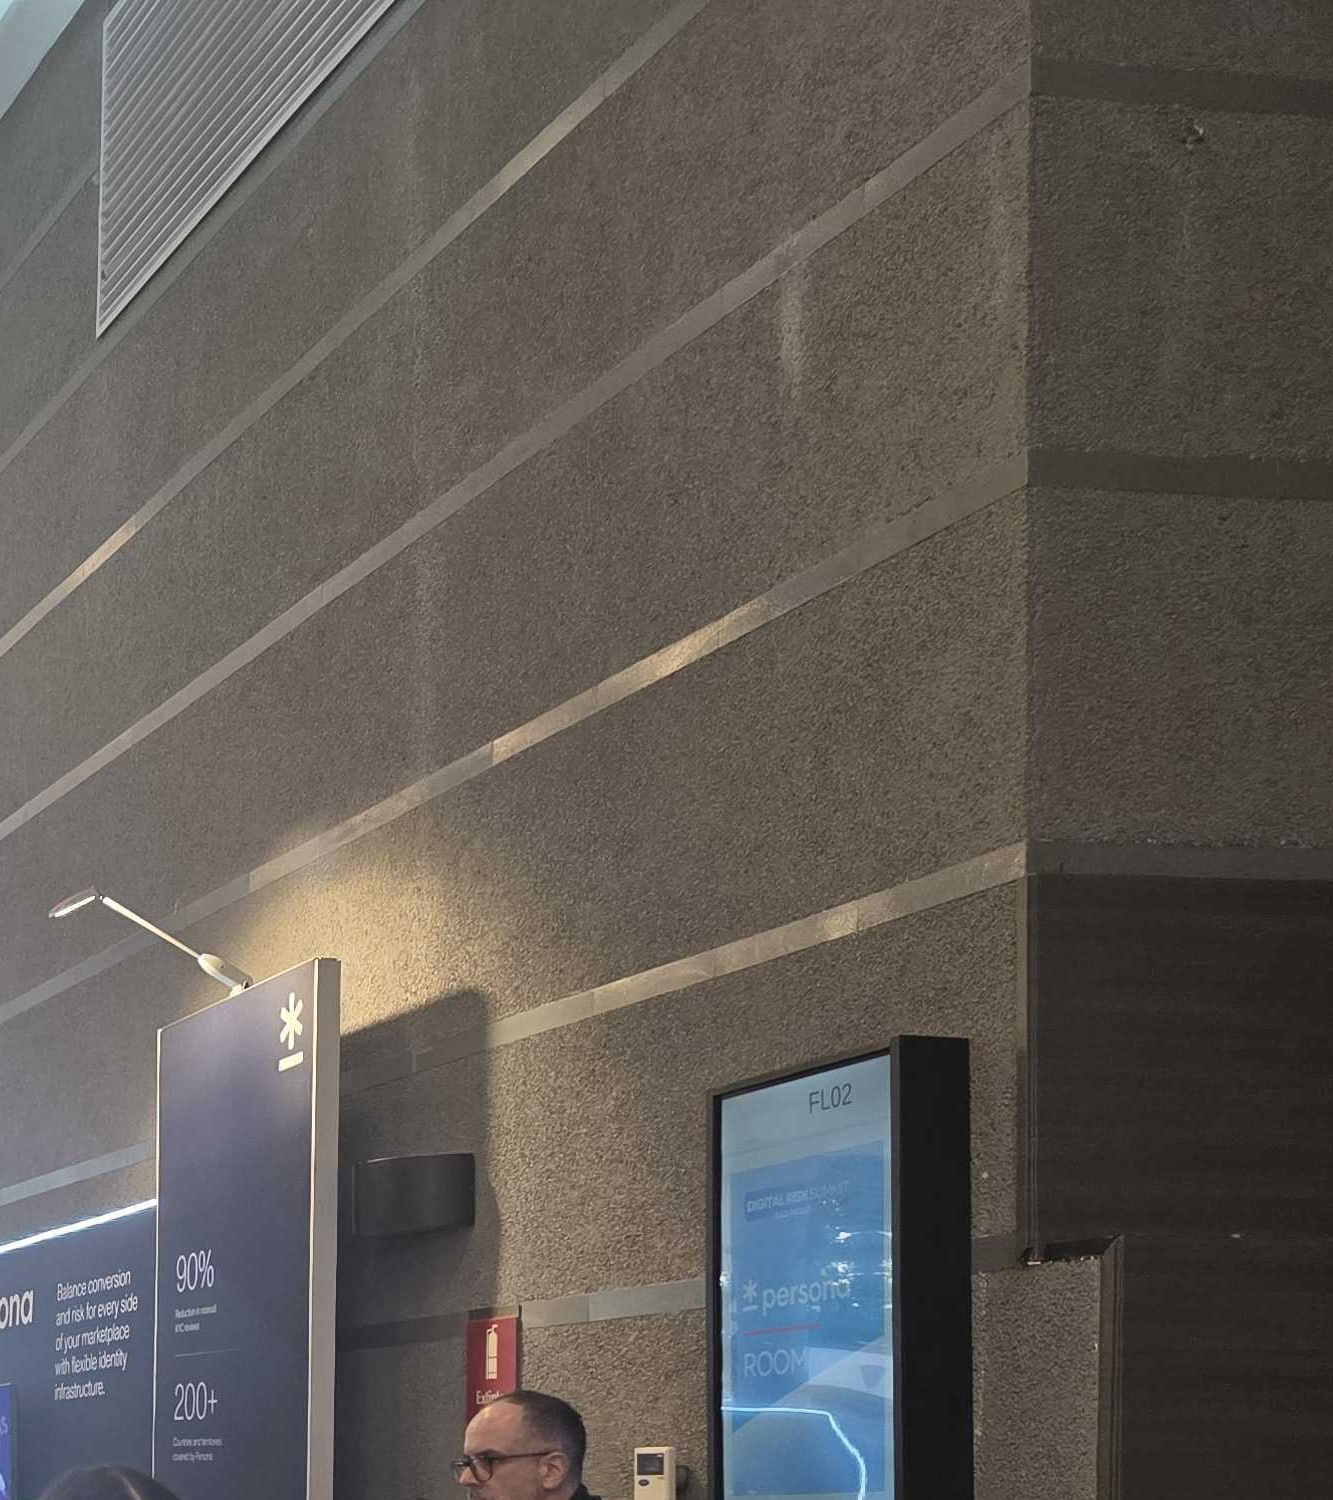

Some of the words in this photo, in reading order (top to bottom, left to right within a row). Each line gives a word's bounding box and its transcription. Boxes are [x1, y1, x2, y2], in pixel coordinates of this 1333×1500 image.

[808, 1082, 853, 1114] FL02
[57, 1283, 87, 1302] Balance
[87, 1270, 131, 1295] conversion
[176, 1248, 215, 1293] 90%
[55, 1308, 71, 1327] and
[71, 1305, 85, 1322] risk
[85, 1302, 97, 1320] for
[97, 1299, 120, 1320] every
[120, 1294, 139, 1312] side
[762, 1278, 851, 1317] persona
[55, 1334, 64, 1351] of
[64, 1333, 81, 1354] your
[82, 1323, 130, 1347] marketplace
[54, 1358, 70, 1376] with
[71, 1353, 98, 1374] flexible
[98, 1348, 129, 1371] identity
[744, 1346, 807, 1377] ROOM
[54, 1380, 106, 1401] infrastructure.
[174, 1381, 218, 1421] 200+
